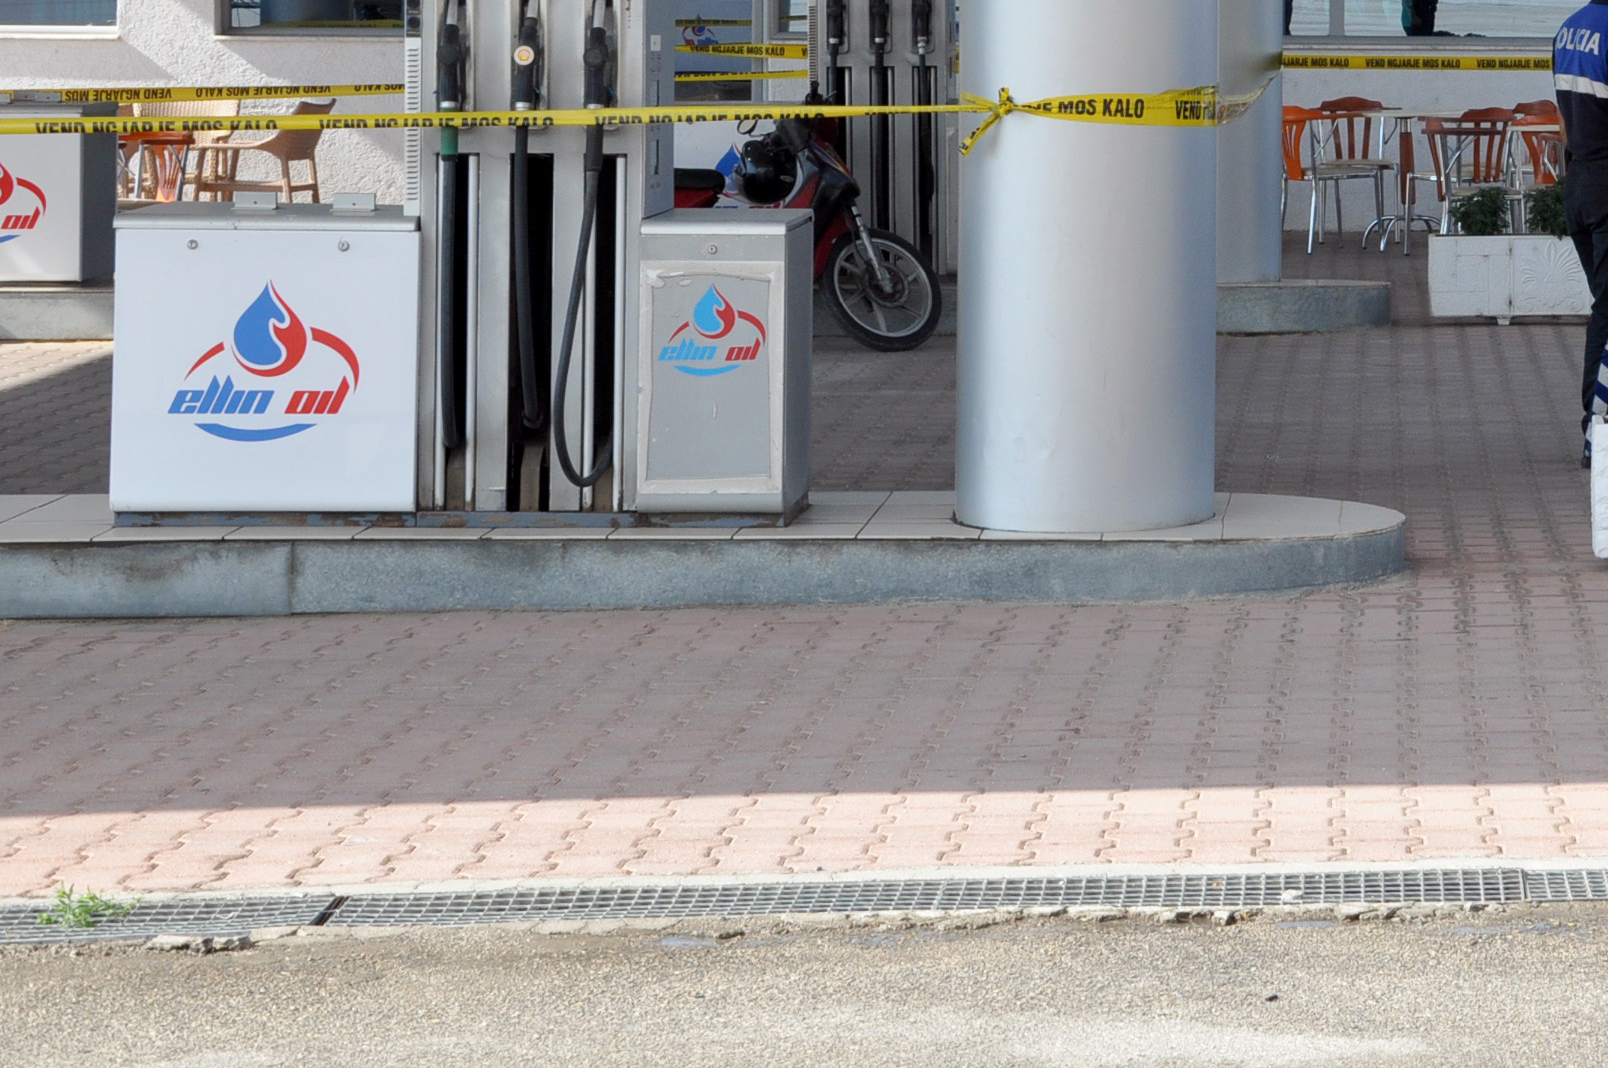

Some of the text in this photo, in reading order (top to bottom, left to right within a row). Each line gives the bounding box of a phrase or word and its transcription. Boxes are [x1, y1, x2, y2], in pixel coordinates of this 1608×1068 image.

[746, 47, 763, 56] MOS
[765, 47, 785, 56] KALO
[1555, 27, 1601, 56] OLICIA
[1310, 58, 1328, 68] MOS
[1329, 58, 1350, 68] KALO
[1365, 58, 1461, 69] VEND NGJARJE MOS KALO
[1476, 59, 1550, 69] VEND NGJARJE MOS
[1057, 99, 1097, 115] MOS
[1102, 98, 1145, 119] KALO
[1175, 100, 1201, 120] VEND
[1, 206, 41, 229] oil
[658, 337, 761, 362] ellin oil
[167, 374, 350, 415] ellin oil
